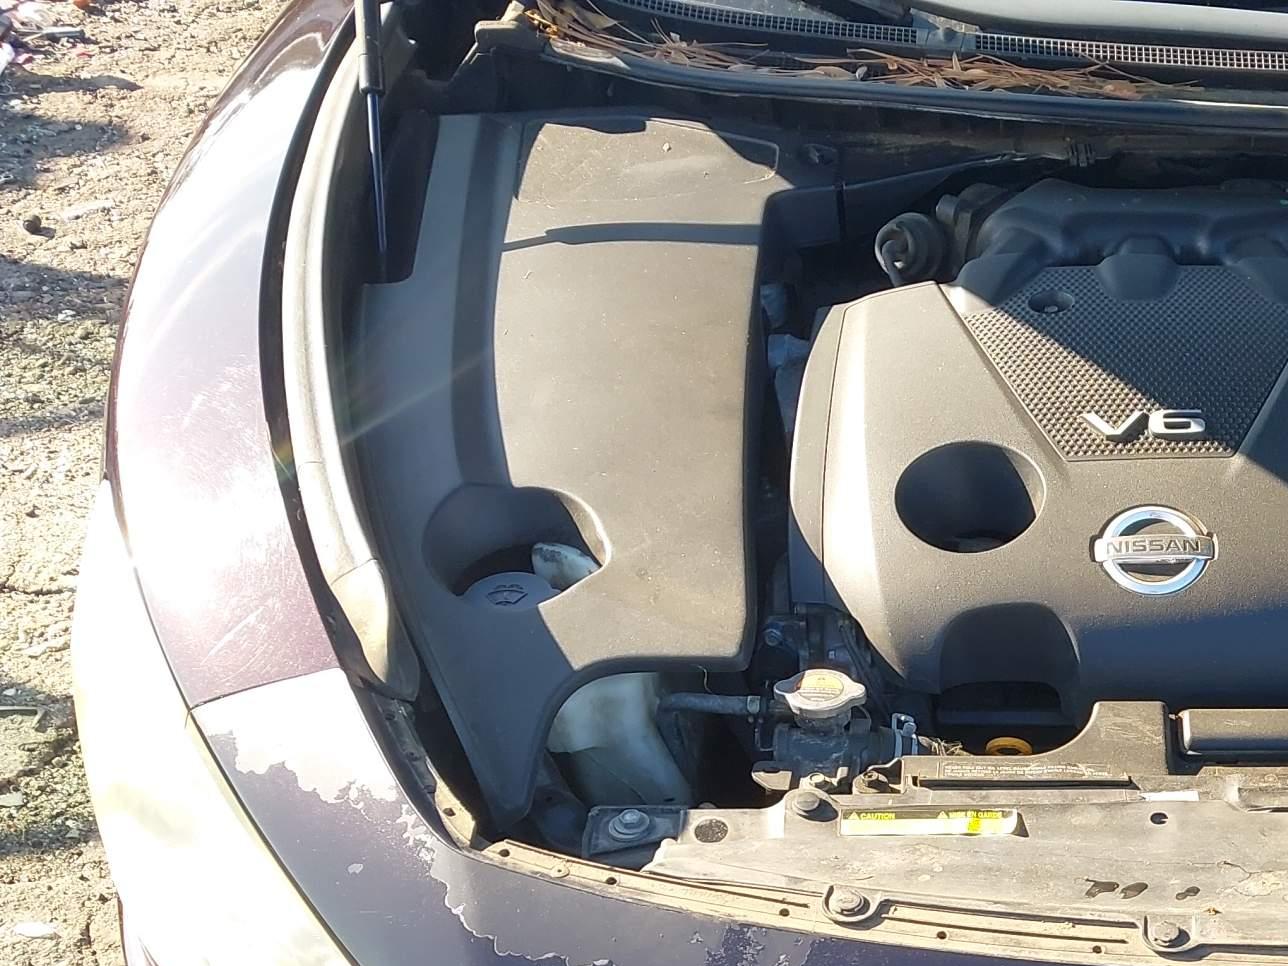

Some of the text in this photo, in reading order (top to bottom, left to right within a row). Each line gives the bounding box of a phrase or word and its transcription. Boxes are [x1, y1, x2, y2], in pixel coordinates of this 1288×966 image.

[1078, 408, 1206, 441] V6
[1106, 538, 1202, 554] NISSAN
[860, 812, 896, 820] CAUTION
